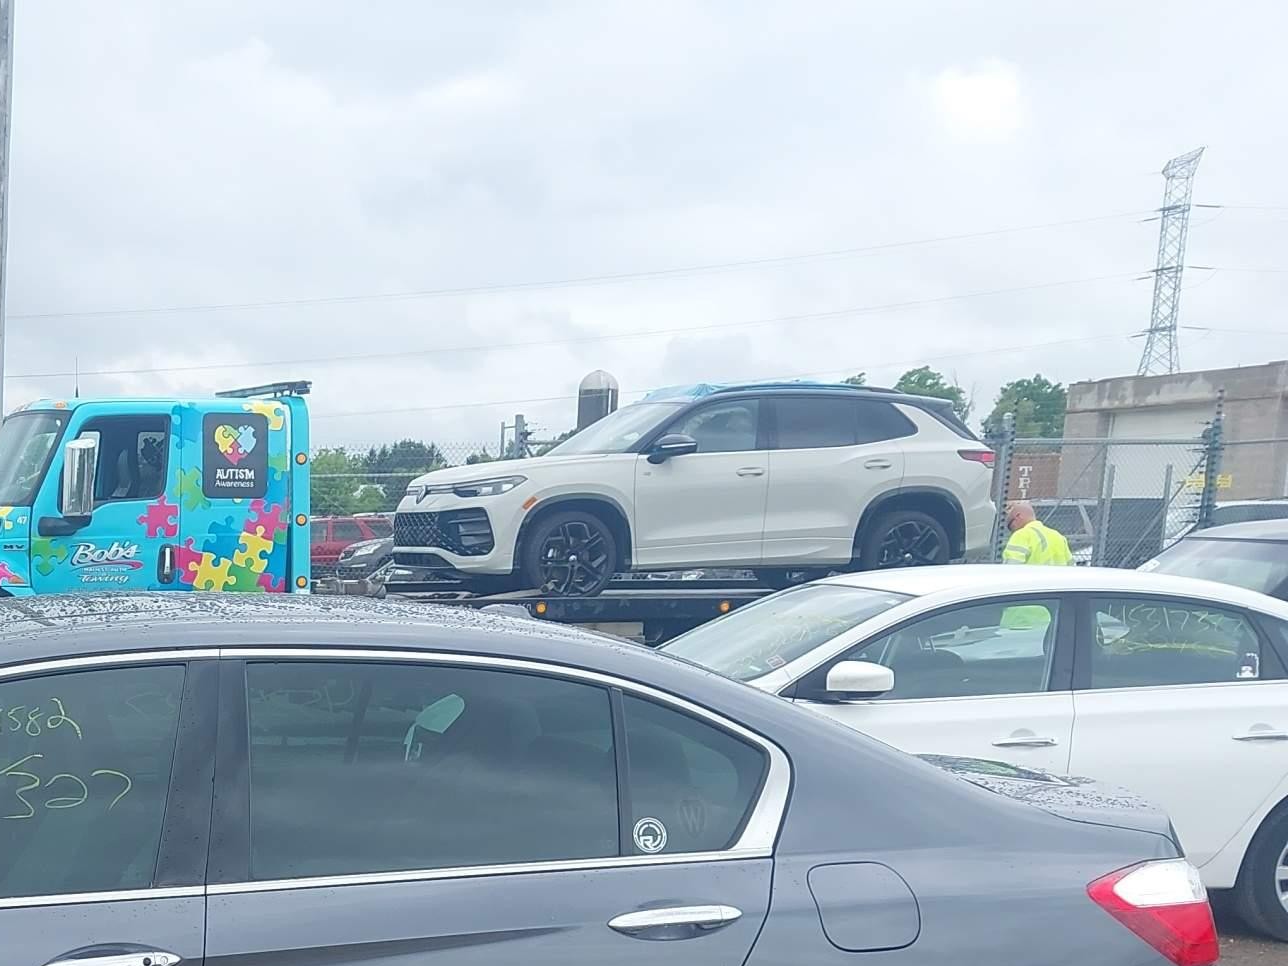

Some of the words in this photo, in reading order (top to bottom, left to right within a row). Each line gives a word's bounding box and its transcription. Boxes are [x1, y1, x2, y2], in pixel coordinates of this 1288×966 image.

[215, 468, 255, 480] AUTISM
[215, 479, 255, 488] Awareness
[72, 541, 139, 565] Bob's
[79, 574, 129, 584] Towing
